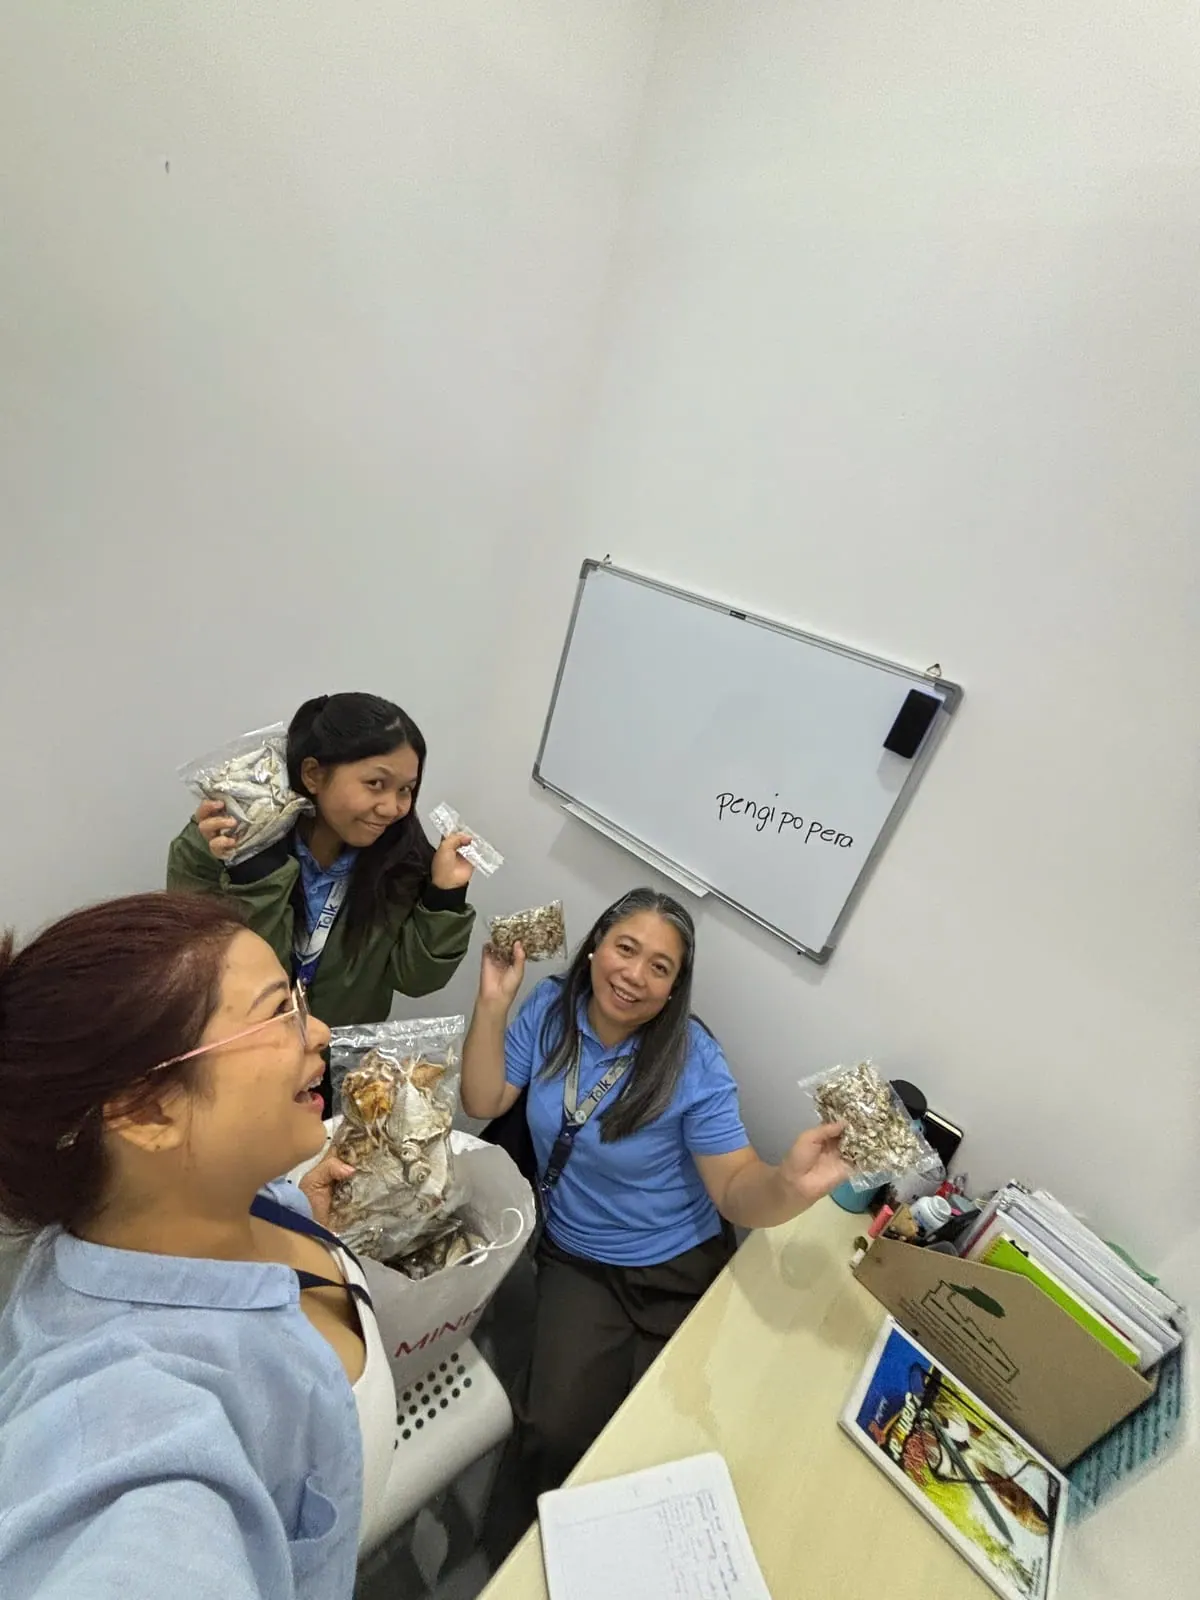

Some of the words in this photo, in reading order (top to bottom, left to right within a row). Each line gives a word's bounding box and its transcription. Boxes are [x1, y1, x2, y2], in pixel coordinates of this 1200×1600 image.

[777, 811, 803, 833] po
[316, 904, 338, 930] Talk
[589, 1079, 611, 1103] Talk
